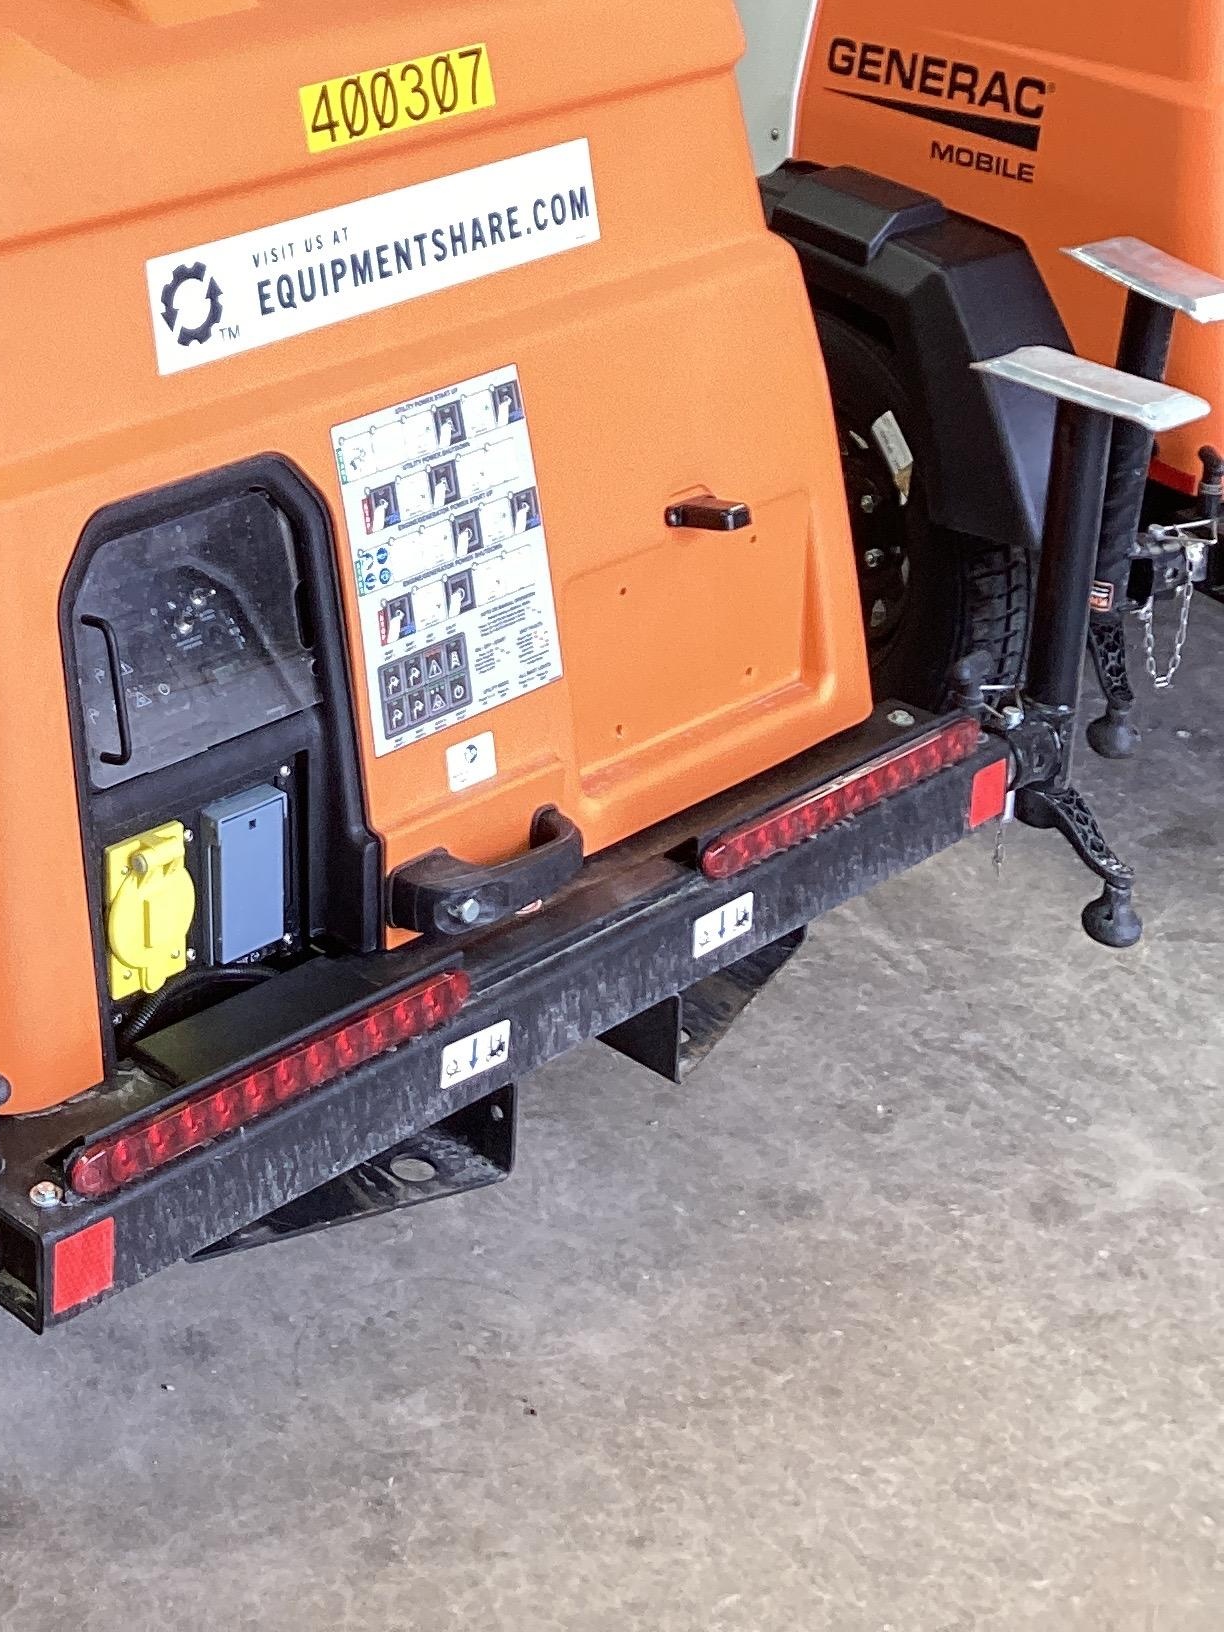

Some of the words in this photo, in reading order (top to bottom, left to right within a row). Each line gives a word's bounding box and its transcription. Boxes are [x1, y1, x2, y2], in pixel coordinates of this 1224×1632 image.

[311, 47, 483, 142] 400307
[827, 37, 1047, 119] GENERAC
[930, 140, 1036, 183] MOBILE
[252, 241, 296, 268] VISIT
[305, 234, 324, 254] US
[333, 227, 350, 246] AT
[257, 186, 590, 316] EQUIPMENTSHARE.COM
[219, 324, 241, 341] TM
